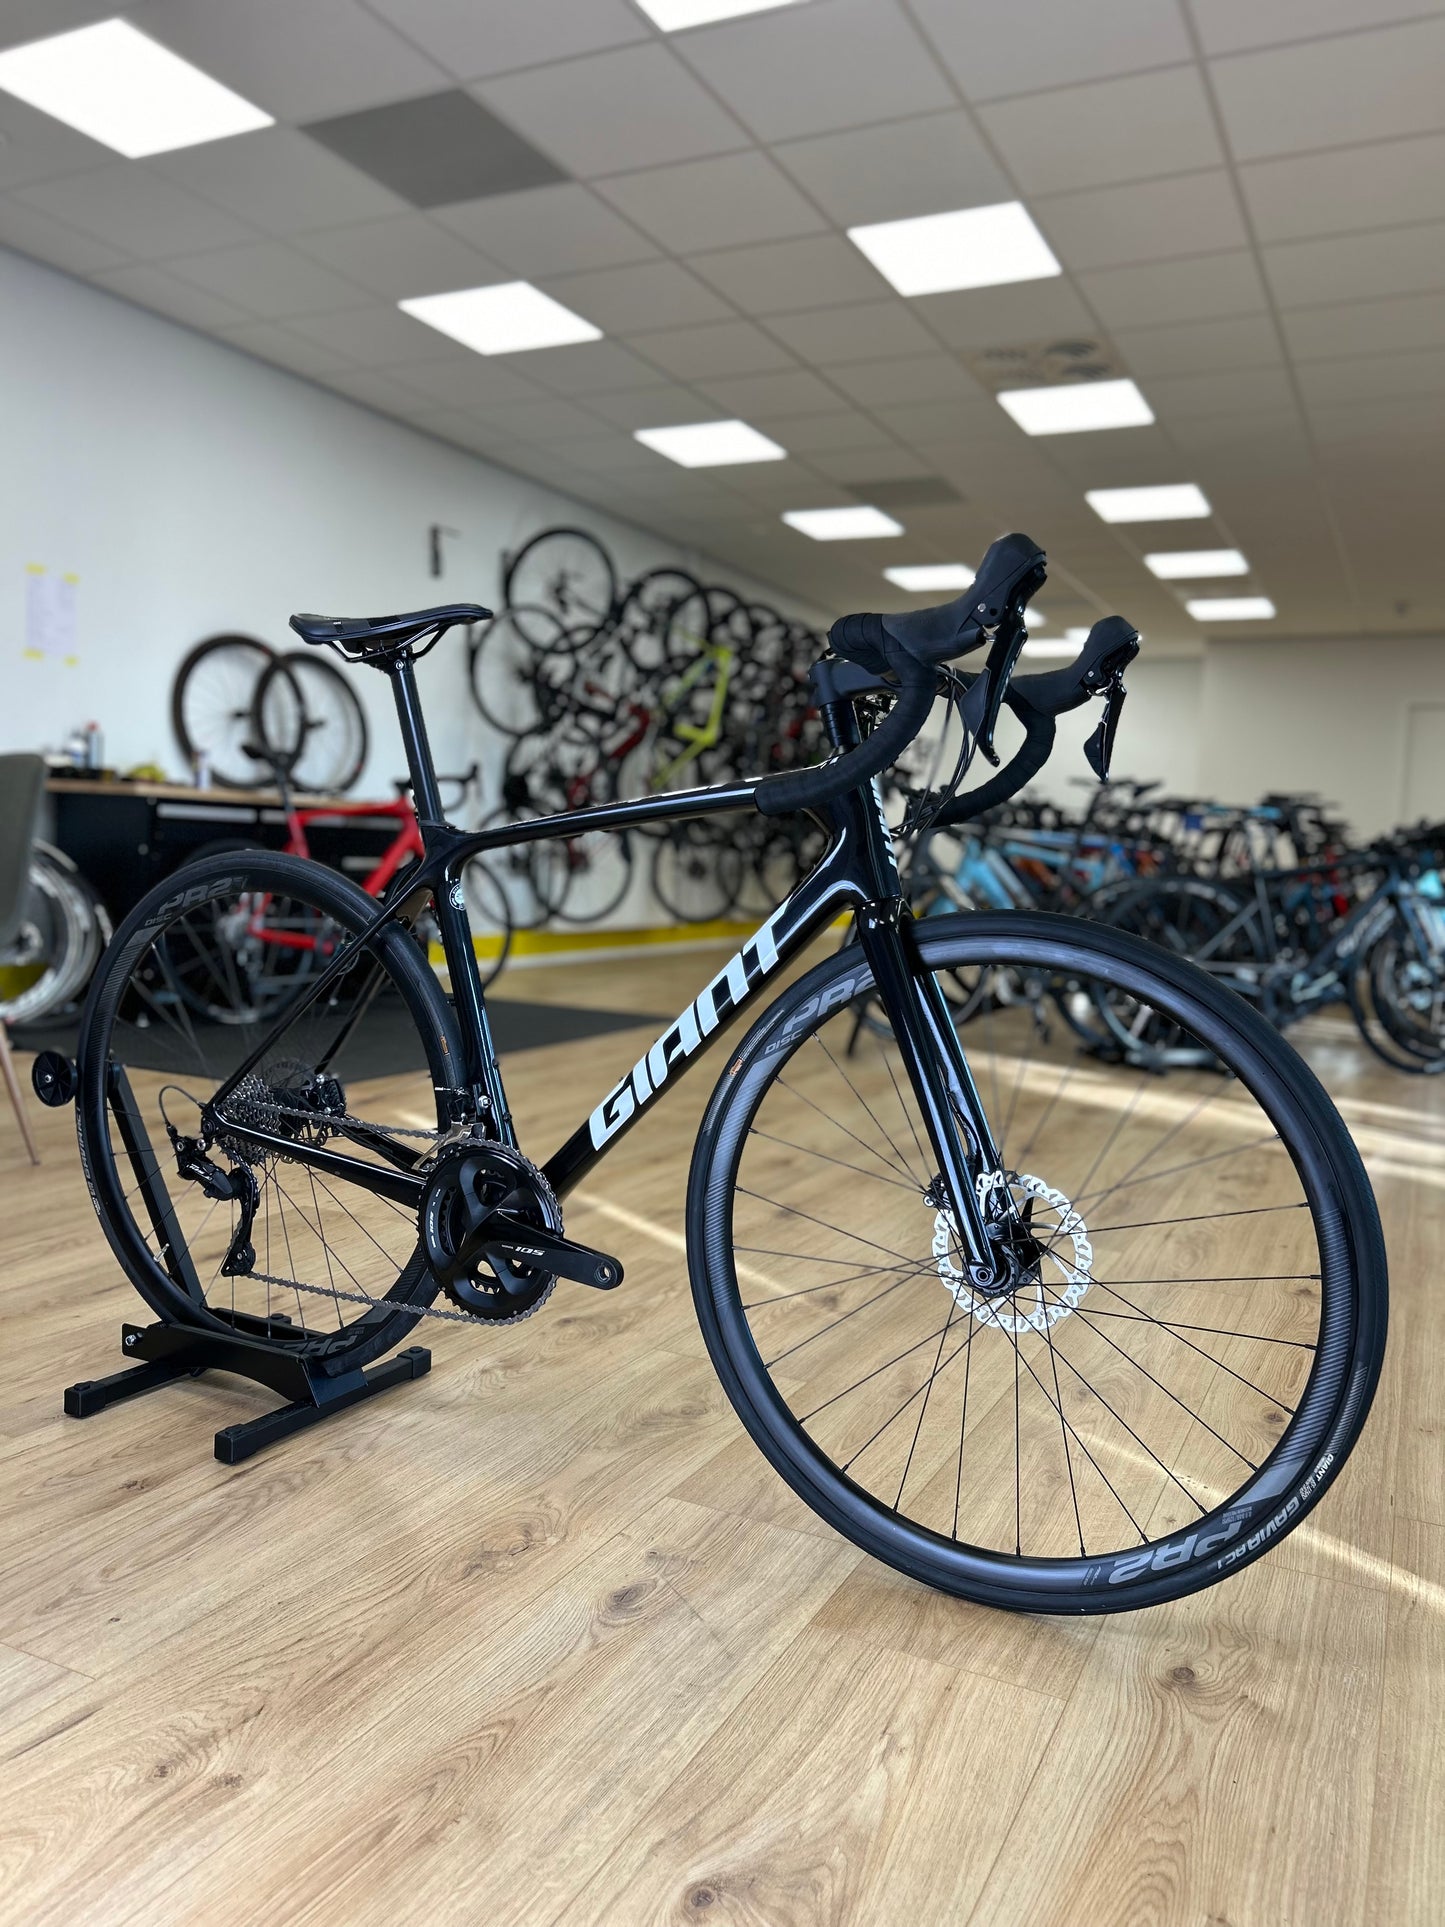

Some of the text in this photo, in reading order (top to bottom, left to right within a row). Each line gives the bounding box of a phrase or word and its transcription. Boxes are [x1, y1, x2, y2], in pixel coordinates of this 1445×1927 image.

[157, 877, 233, 916] PR2
[589, 899, 790, 1151] GIANT
[764, 1028, 804, 1055] DISC
[515, 1246, 546, 1257] 105
[1315, 1453, 1335, 1482] GIANT
[1247, 1496, 1301, 1551] GAVIA
[1109, 1520, 1243, 1585] PR2
